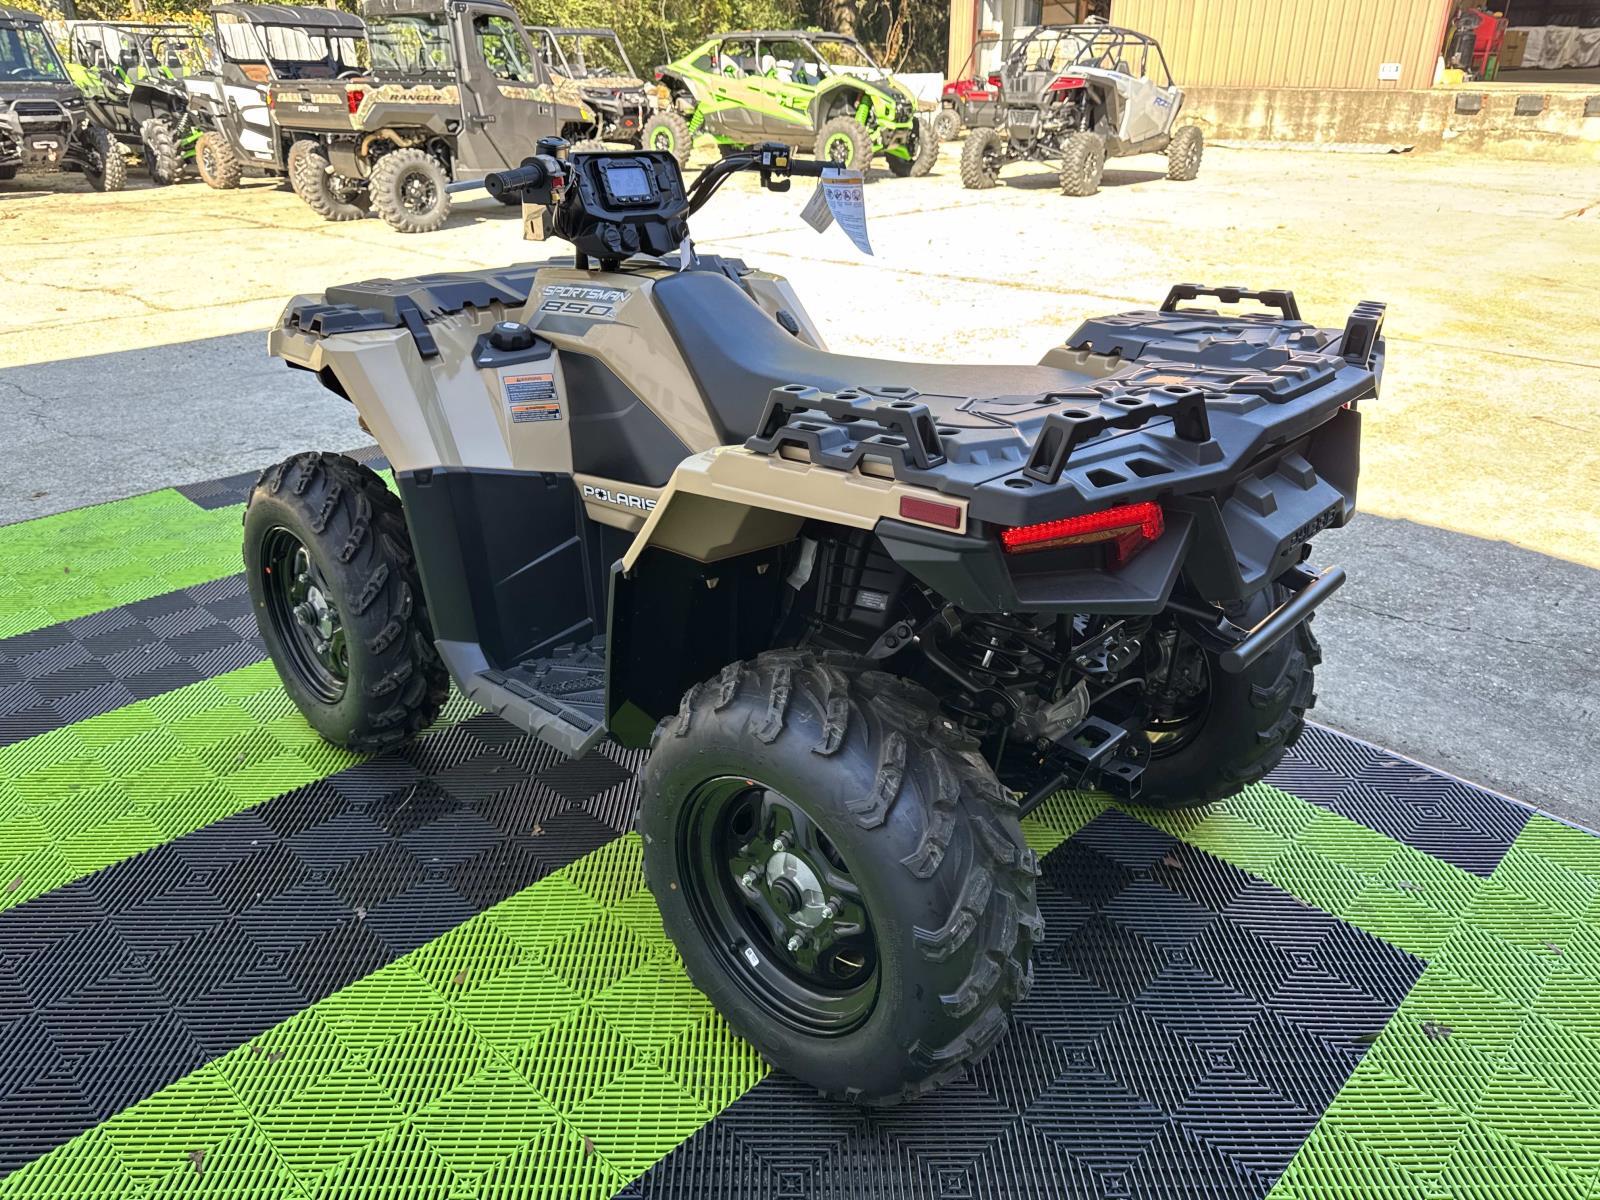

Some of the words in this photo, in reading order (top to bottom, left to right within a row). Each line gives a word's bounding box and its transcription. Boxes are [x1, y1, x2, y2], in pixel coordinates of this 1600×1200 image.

[542, 285, 632, 303] SPORTSMAN
[541, 301, 613, 316] 850
[583, 485, 657, 511] POLARIS
